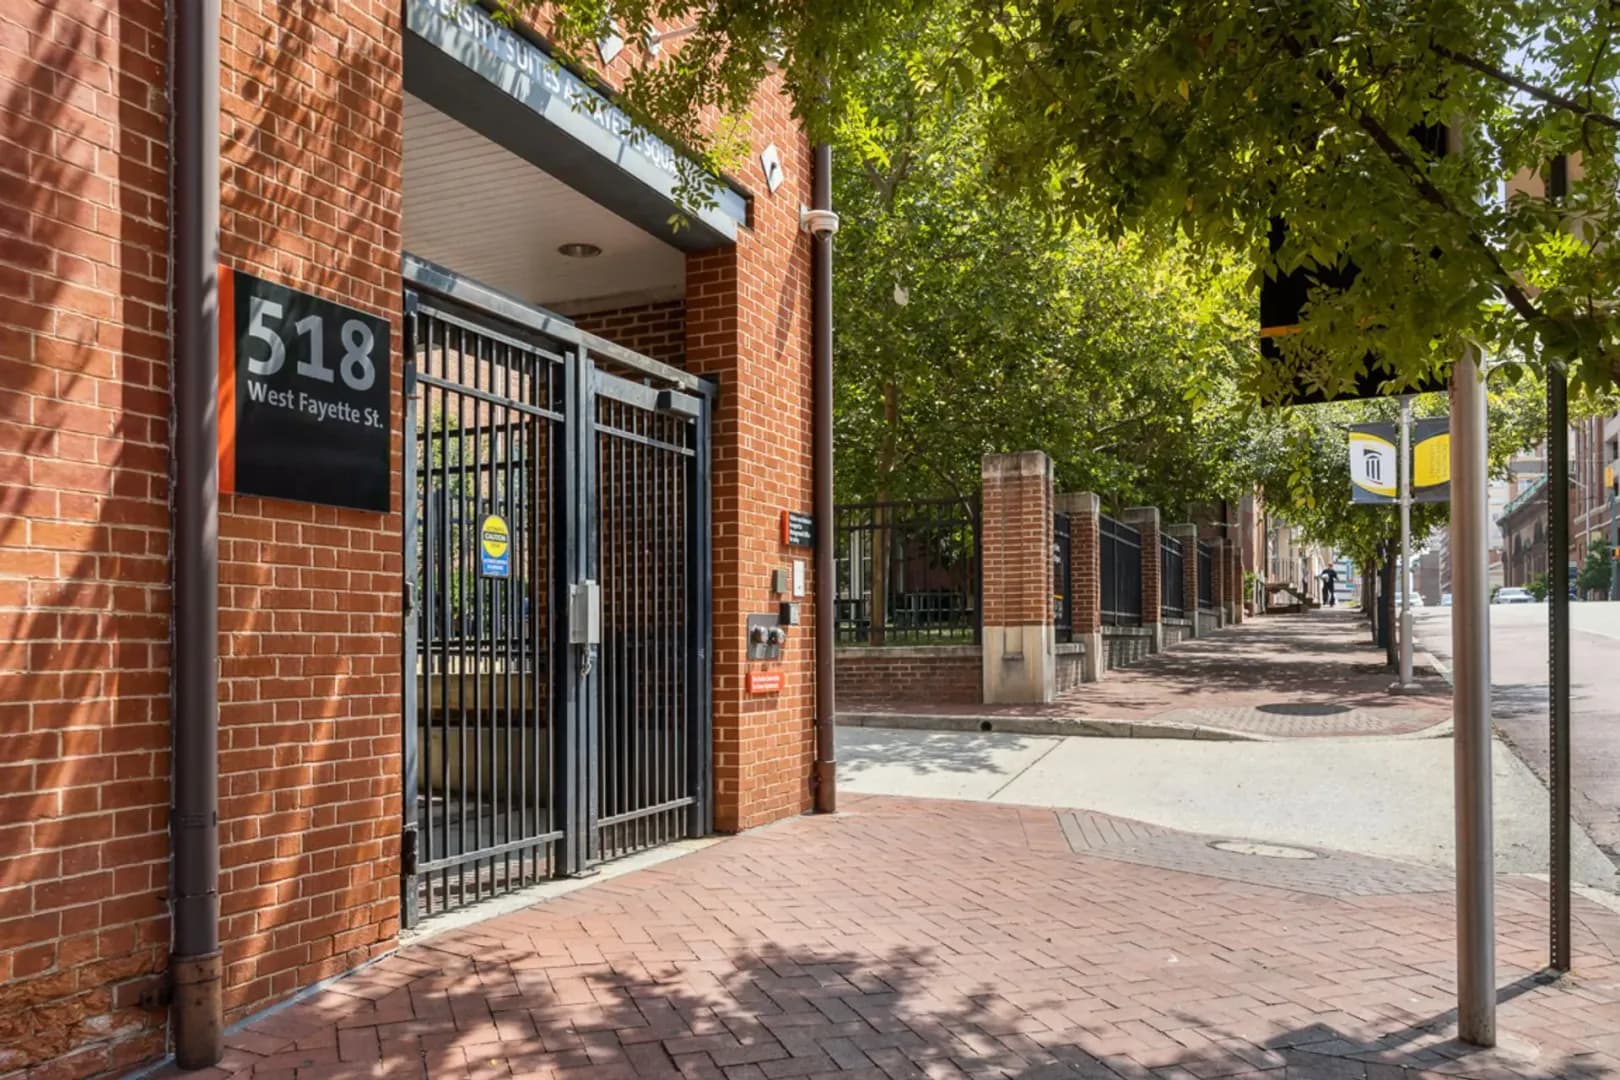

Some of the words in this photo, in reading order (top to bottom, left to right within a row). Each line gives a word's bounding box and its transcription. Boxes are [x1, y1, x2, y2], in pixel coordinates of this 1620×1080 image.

[248, 296, 376, 391] 518
[247, 379, 295, 410] West
[299, 391, 361, 422] Fayette
[364, 407, 384, 429] St.
